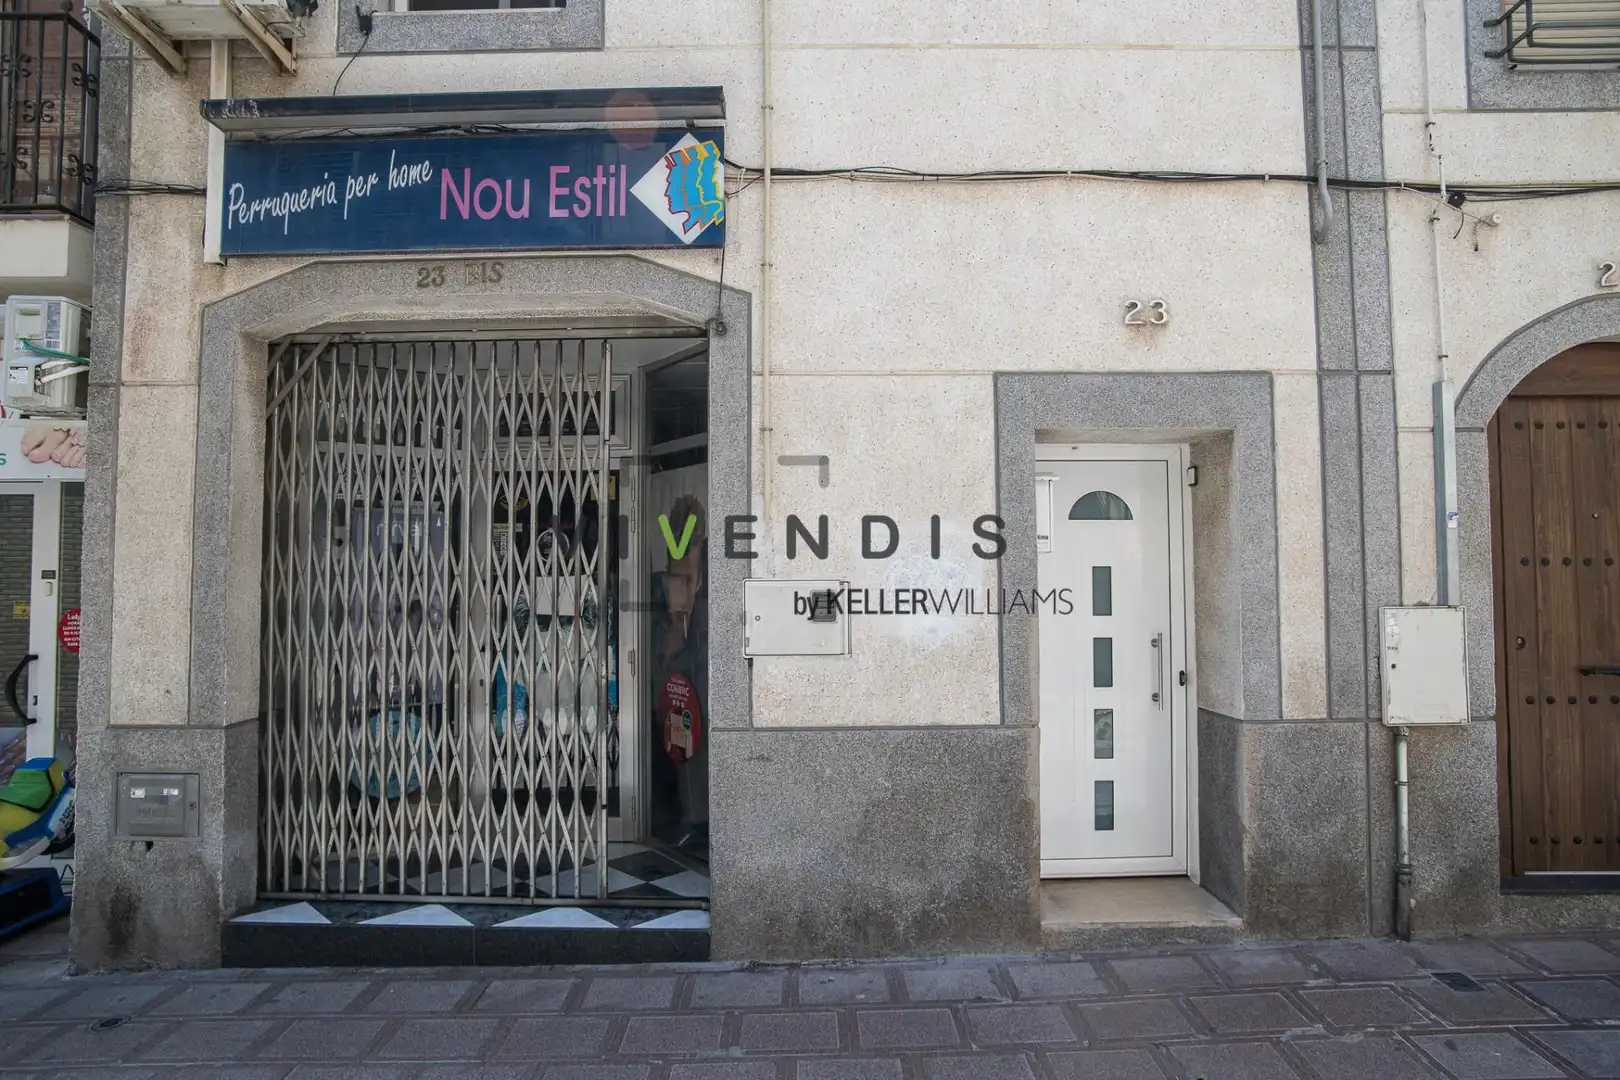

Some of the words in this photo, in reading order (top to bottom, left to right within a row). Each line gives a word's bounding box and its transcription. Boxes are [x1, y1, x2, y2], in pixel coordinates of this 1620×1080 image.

[228, 171, 338, 236] Perruqueria
[343, 174, 379, 221] per
[388, 148, 433, 191] home
[439, 167, 531, 220] Nou
[548, 164, 627, 218] Estil
[416, 265, 446, 288] 23
[464, 261, 504, 286] BIS
[1123, 299, 1168, 326] 23
